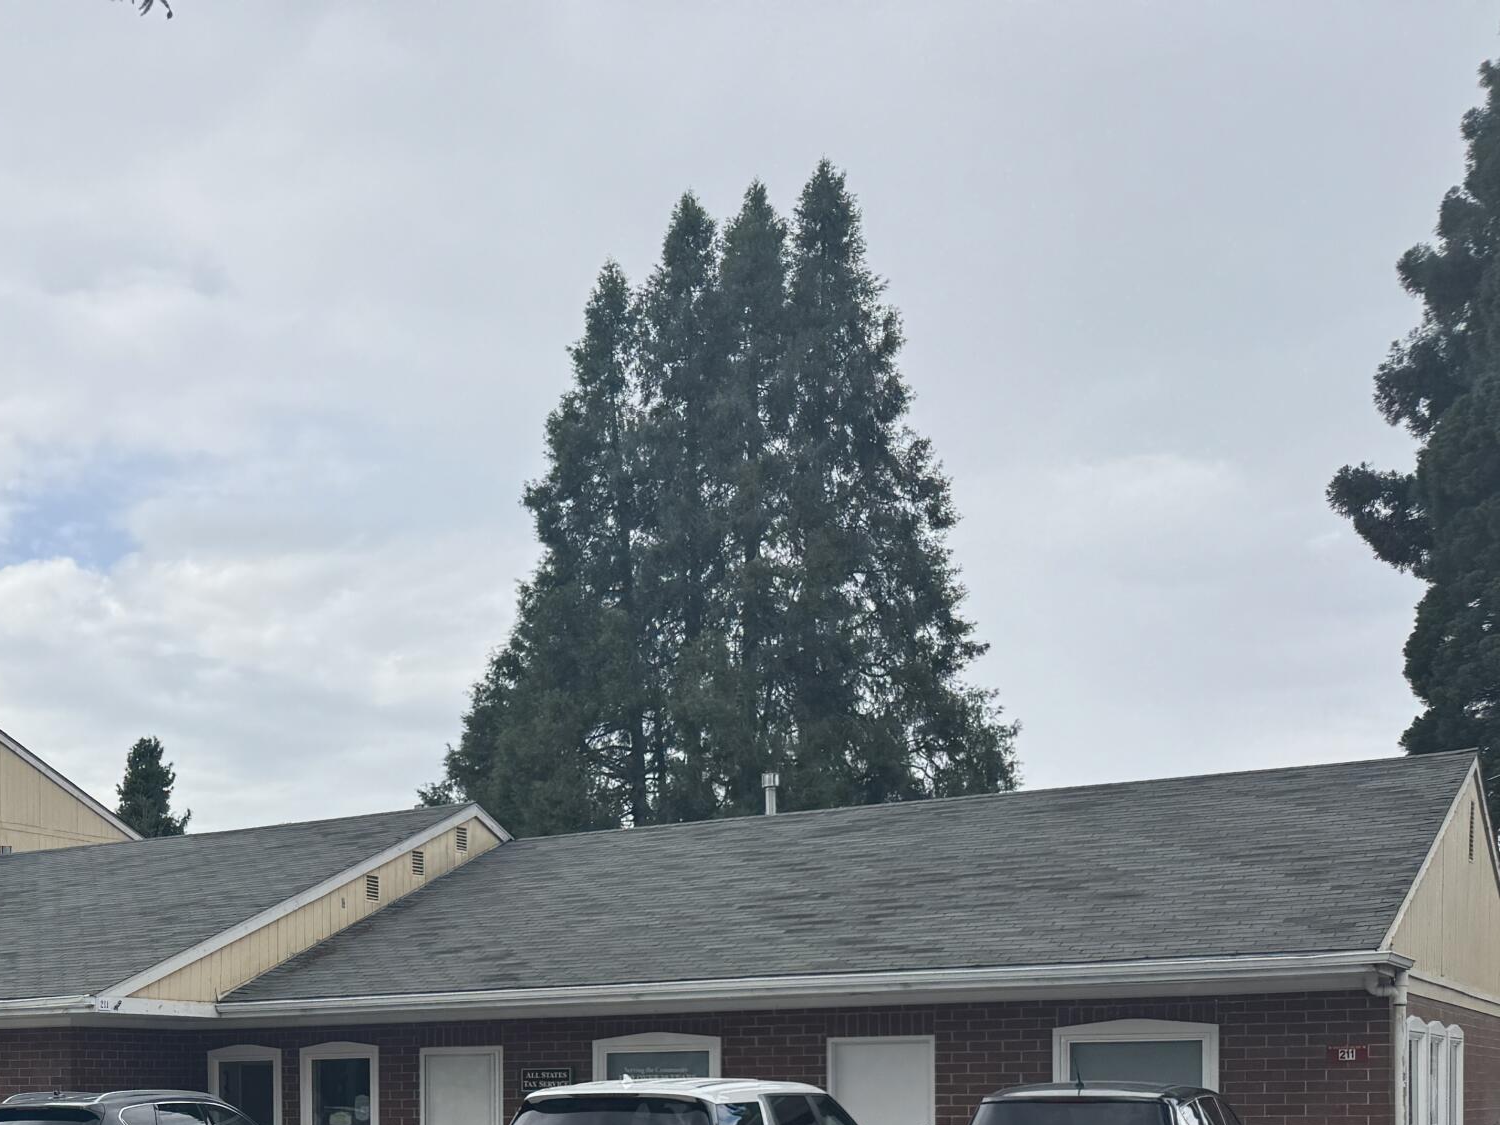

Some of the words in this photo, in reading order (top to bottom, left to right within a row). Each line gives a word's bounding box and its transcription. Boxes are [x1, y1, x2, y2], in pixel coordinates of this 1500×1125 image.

[1339, 1050, 1354, 1060] 211
[526, 1071, 541, 1079] ALL
[541, 1071, 568, 1079] STATES
[523, 1080, 538, 1088] TAX
